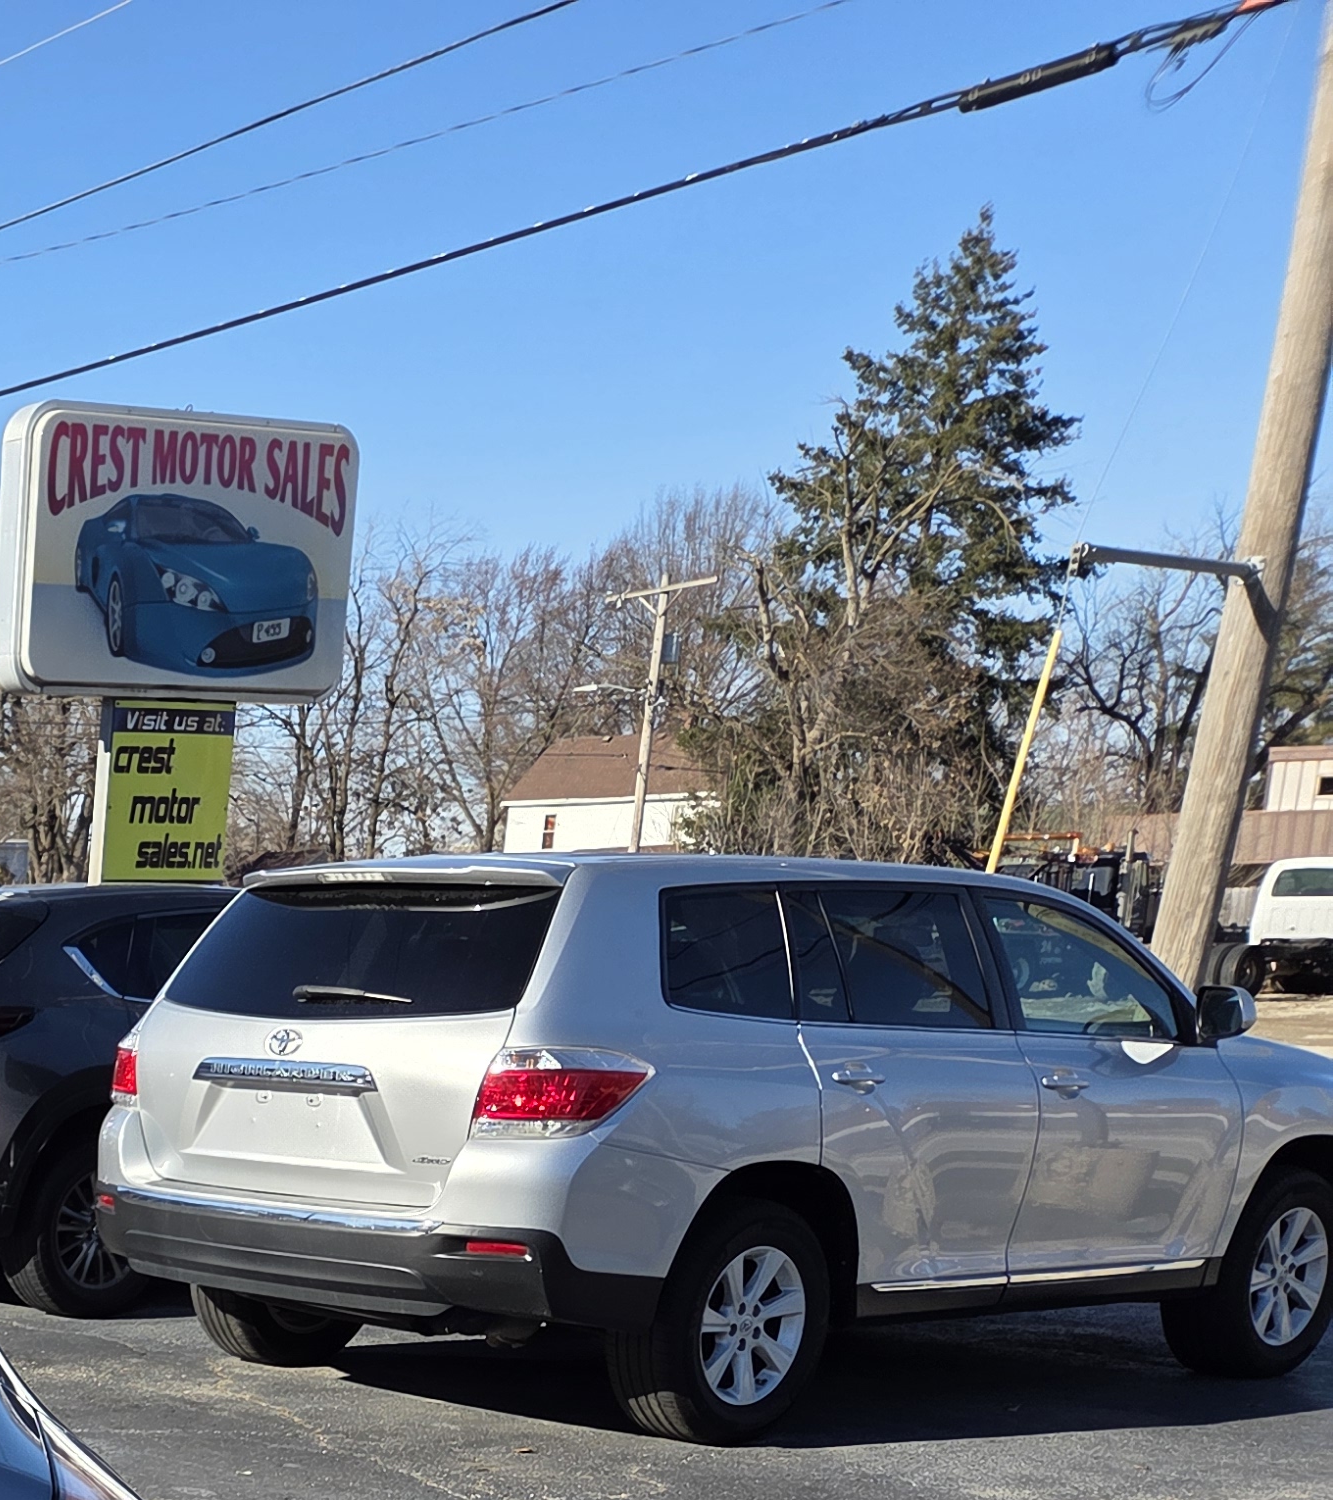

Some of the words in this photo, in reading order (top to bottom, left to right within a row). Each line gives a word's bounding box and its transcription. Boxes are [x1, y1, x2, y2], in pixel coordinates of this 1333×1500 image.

[47, 420, 147, 517] CREST
[151, 428, 257, 494] MOTOR
[264, 437, 351, 538] SALES
[127, 710, 169, 731] Visit
[173, 716, 199, 731] us
[203, 714, 226, 732] at:
[113, 738, 176, 774] crest
[129, 788, 201, 824] motor
[135, 833, 222, 869] sales.net
